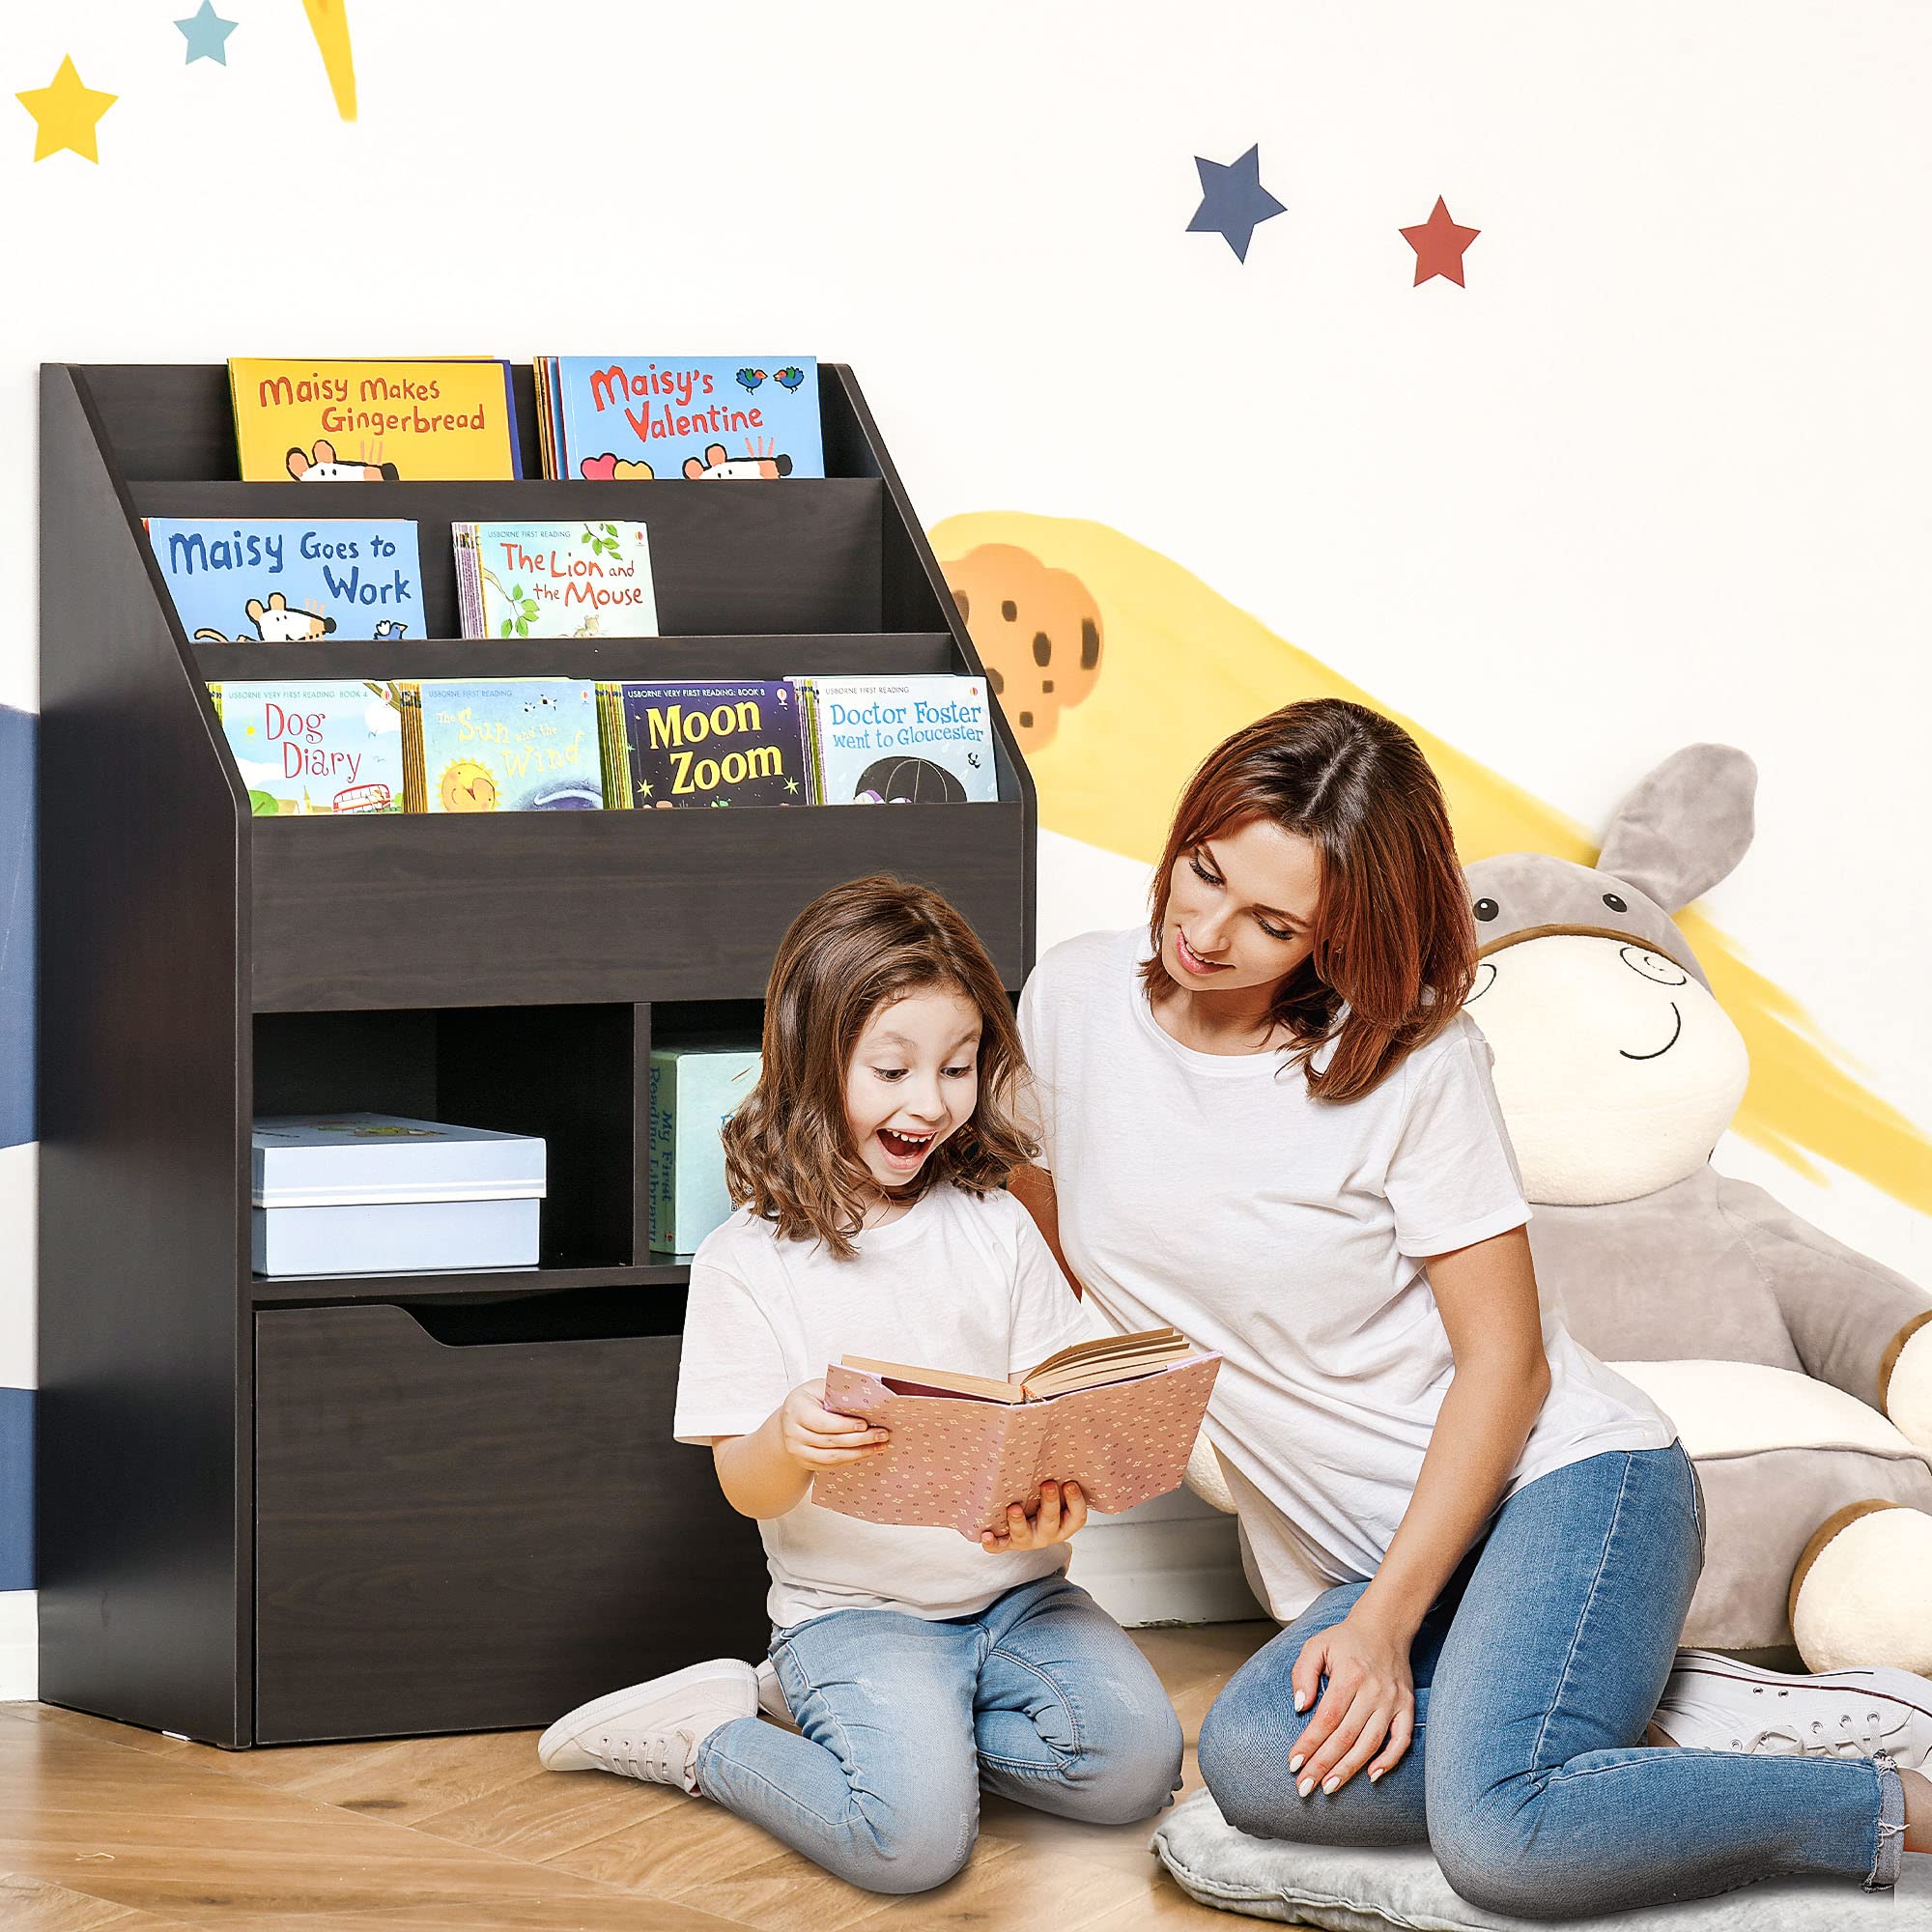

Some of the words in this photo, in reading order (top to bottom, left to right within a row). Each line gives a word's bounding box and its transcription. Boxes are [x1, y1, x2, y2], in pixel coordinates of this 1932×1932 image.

[260, 372, 349, 408] Maisy
[359, 377, 440, 402] Makes
[589, 364, 714, 412] Maisy's
[322, 404, 485, 437] Gingerbread
[624, 401, 764, 443] Valentine
[168, 530, 283, 576] Maisy
[299, 531, 359, 560] Goes
[370, 534, 396, 557] to
[488, 530, 520, 539] USBORNE
[522, 530, 539, 539] FIRST
[499, 542, 546, 574] The
[550, 551, 604, 579] Lion
[609, 560, 635, 578] and
[323, 564, 412, 606] Work
[533, 582, 559, 601] the
[564, 582, 643, 611] Mouse
[229, 691, 262, 699] USBORNE
[482, 689, 513, 697] READING
[627, 690, 662, 698] USBORNE
[663, 689, 681, 697] VERY
[701, 688, 736, 696] READING:
[737, 688, 758, 696] BOOK
[825, 687, 858, 696] USBORNE
[878, 686, 910, 695] READING
[266, 702, 327, 745] Dog
[436, 711, 456, 724] The
[457, 706, 511, 745] Sun
[514, 725, 536, 743] and
[539, 724, 557, 738] the
[645, 700, 762, 751] Moon
[830, 701, 907, 726] Doctor
[914, 700, 982, 724] Foster
[500, 730, 585, 779] Wind
[833, 727, 871, 750] went
[876, 729, 894, 749] to
[896, 724, 984, 746] Gloucester
[283, 741, 362, 784] Diary
[669, 745, 784, 796] Zoom
[658, 1110, 673, 1143] My
[662, 1151, 673, 1202] First
